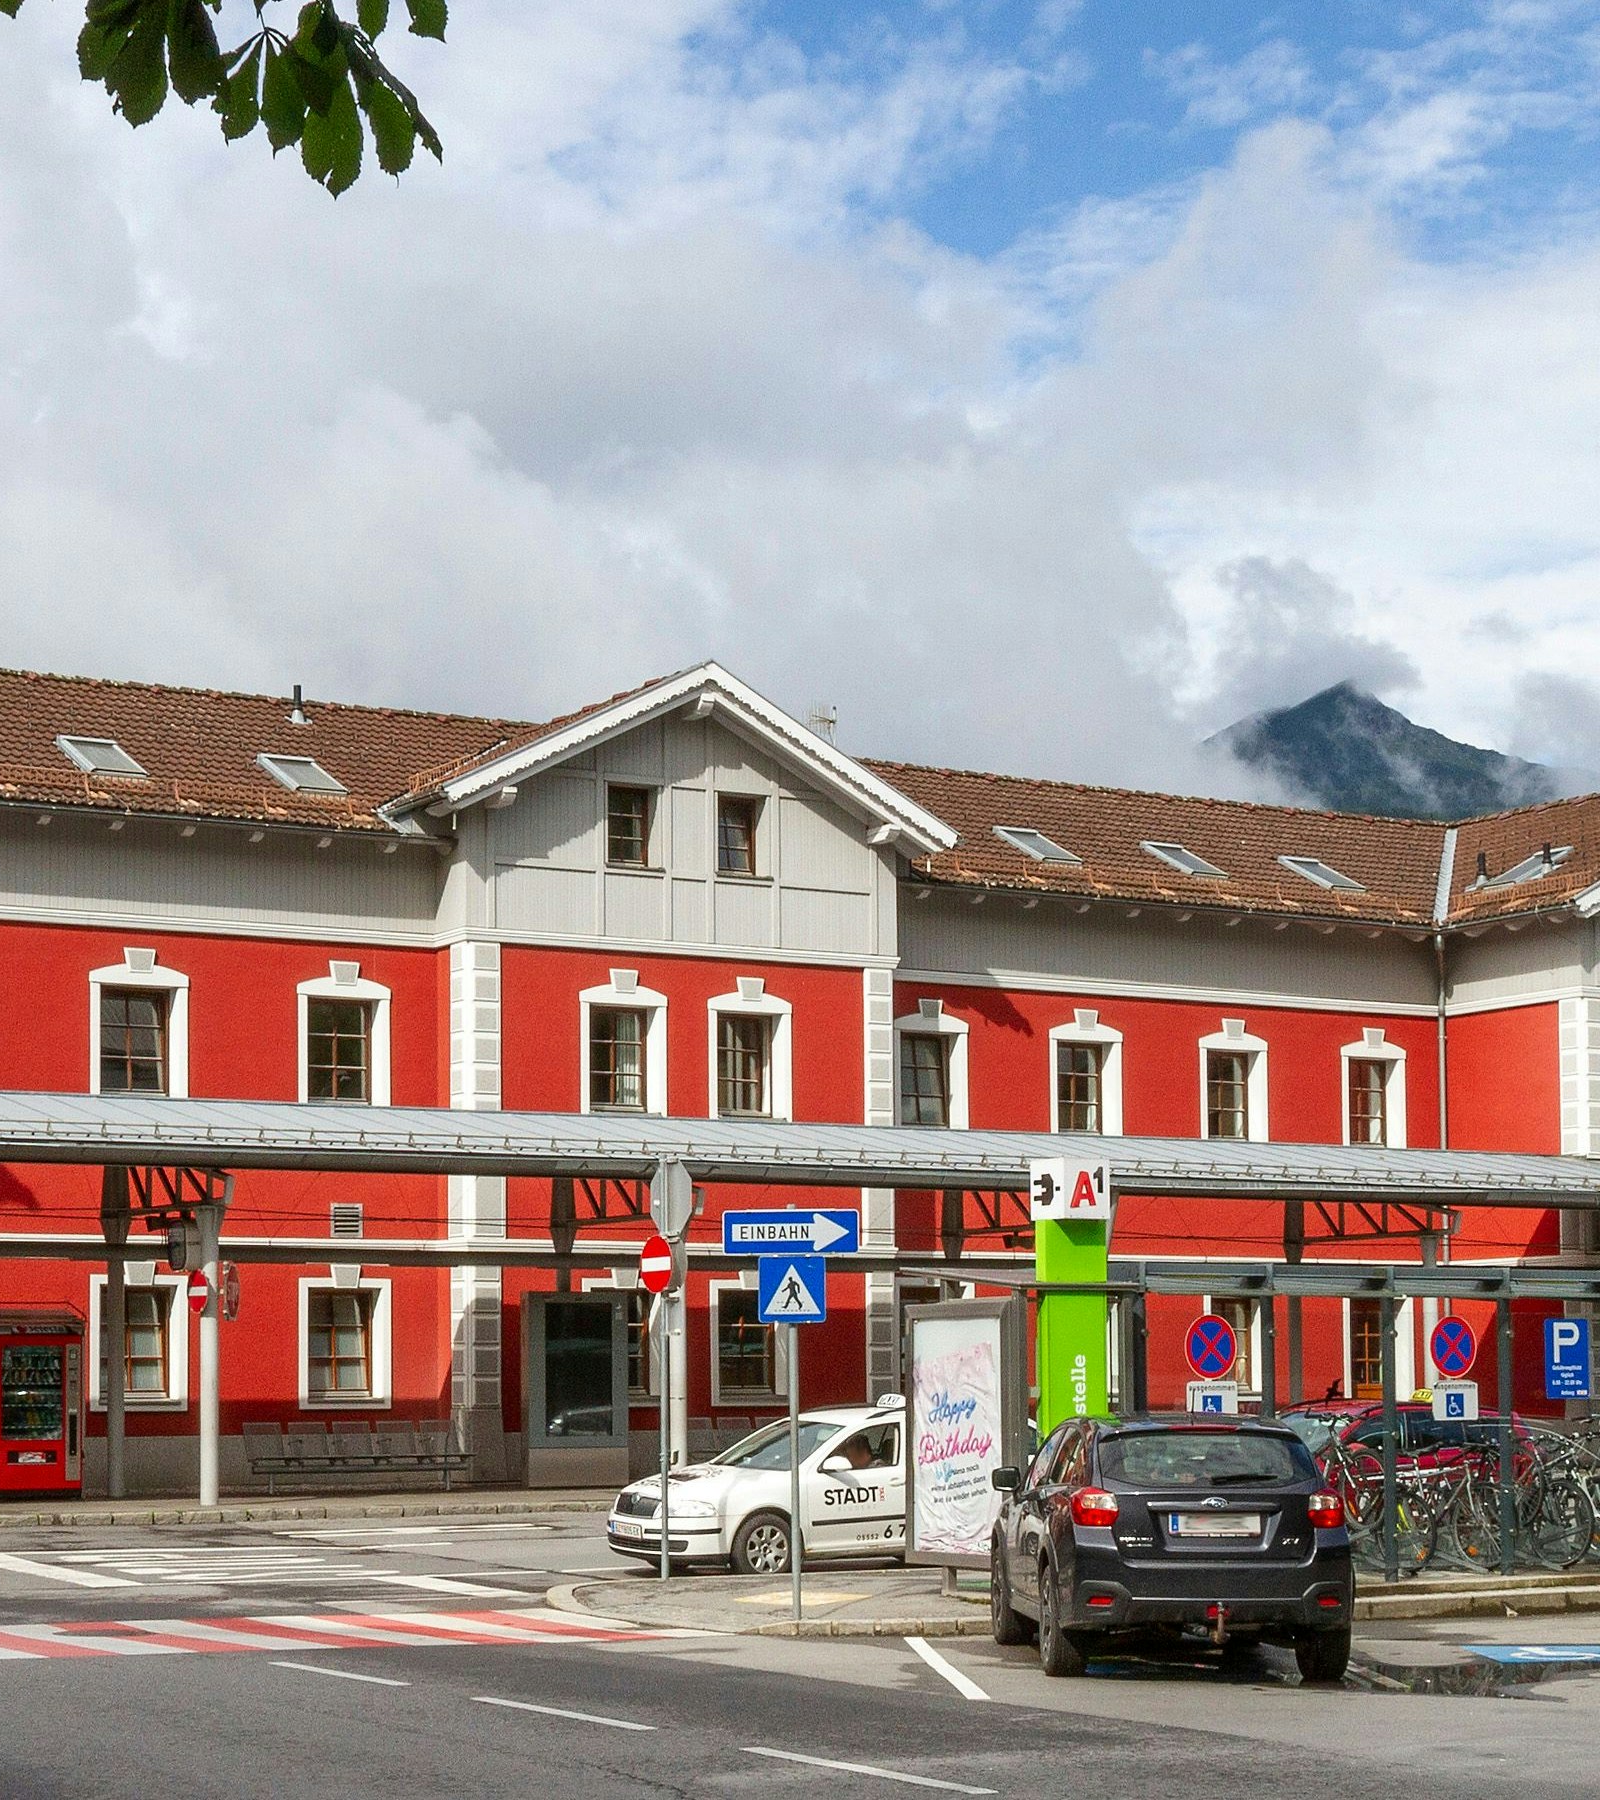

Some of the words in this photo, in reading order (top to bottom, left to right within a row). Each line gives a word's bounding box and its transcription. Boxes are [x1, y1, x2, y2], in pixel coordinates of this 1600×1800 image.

[740, 1226, 809, 1239] EINBAHN
[1553, 1322, 1580, 1364] P
[928, 1391, 976, 1425] Happy
[918, 1425, 992, 1465] Birthday
[824, 1486, 878, 1506] STADT
